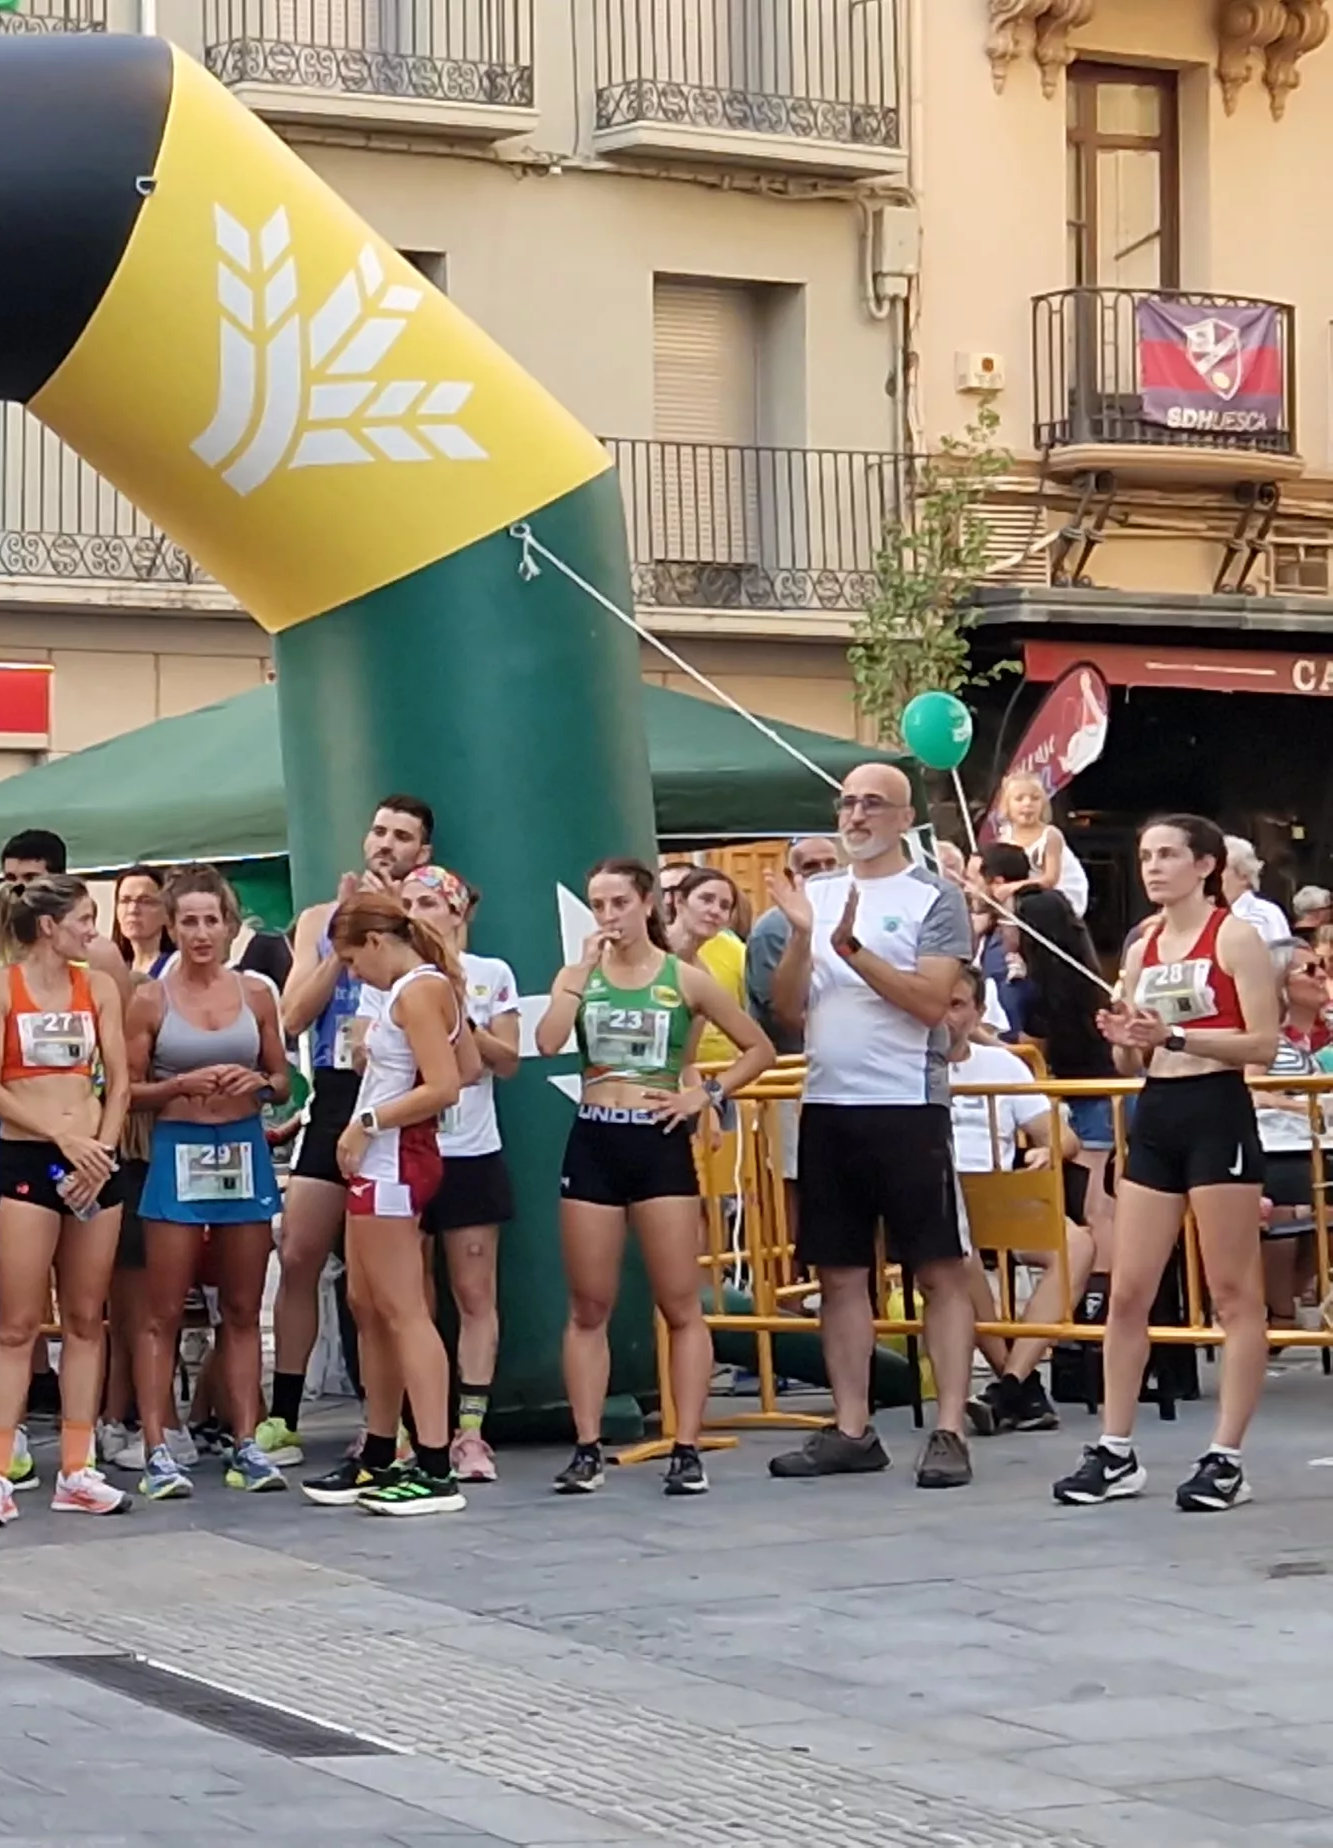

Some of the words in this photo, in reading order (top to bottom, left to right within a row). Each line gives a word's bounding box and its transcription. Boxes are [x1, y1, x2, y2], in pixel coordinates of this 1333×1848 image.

[1155, 963, 1183, 986] 28
[43, 1012, 73, 1031] 27
[610, 1009, 643, 1029] 23
[578, 1104, 668, 1126] UNDE
[199, 1145, 232, 1165] 29
